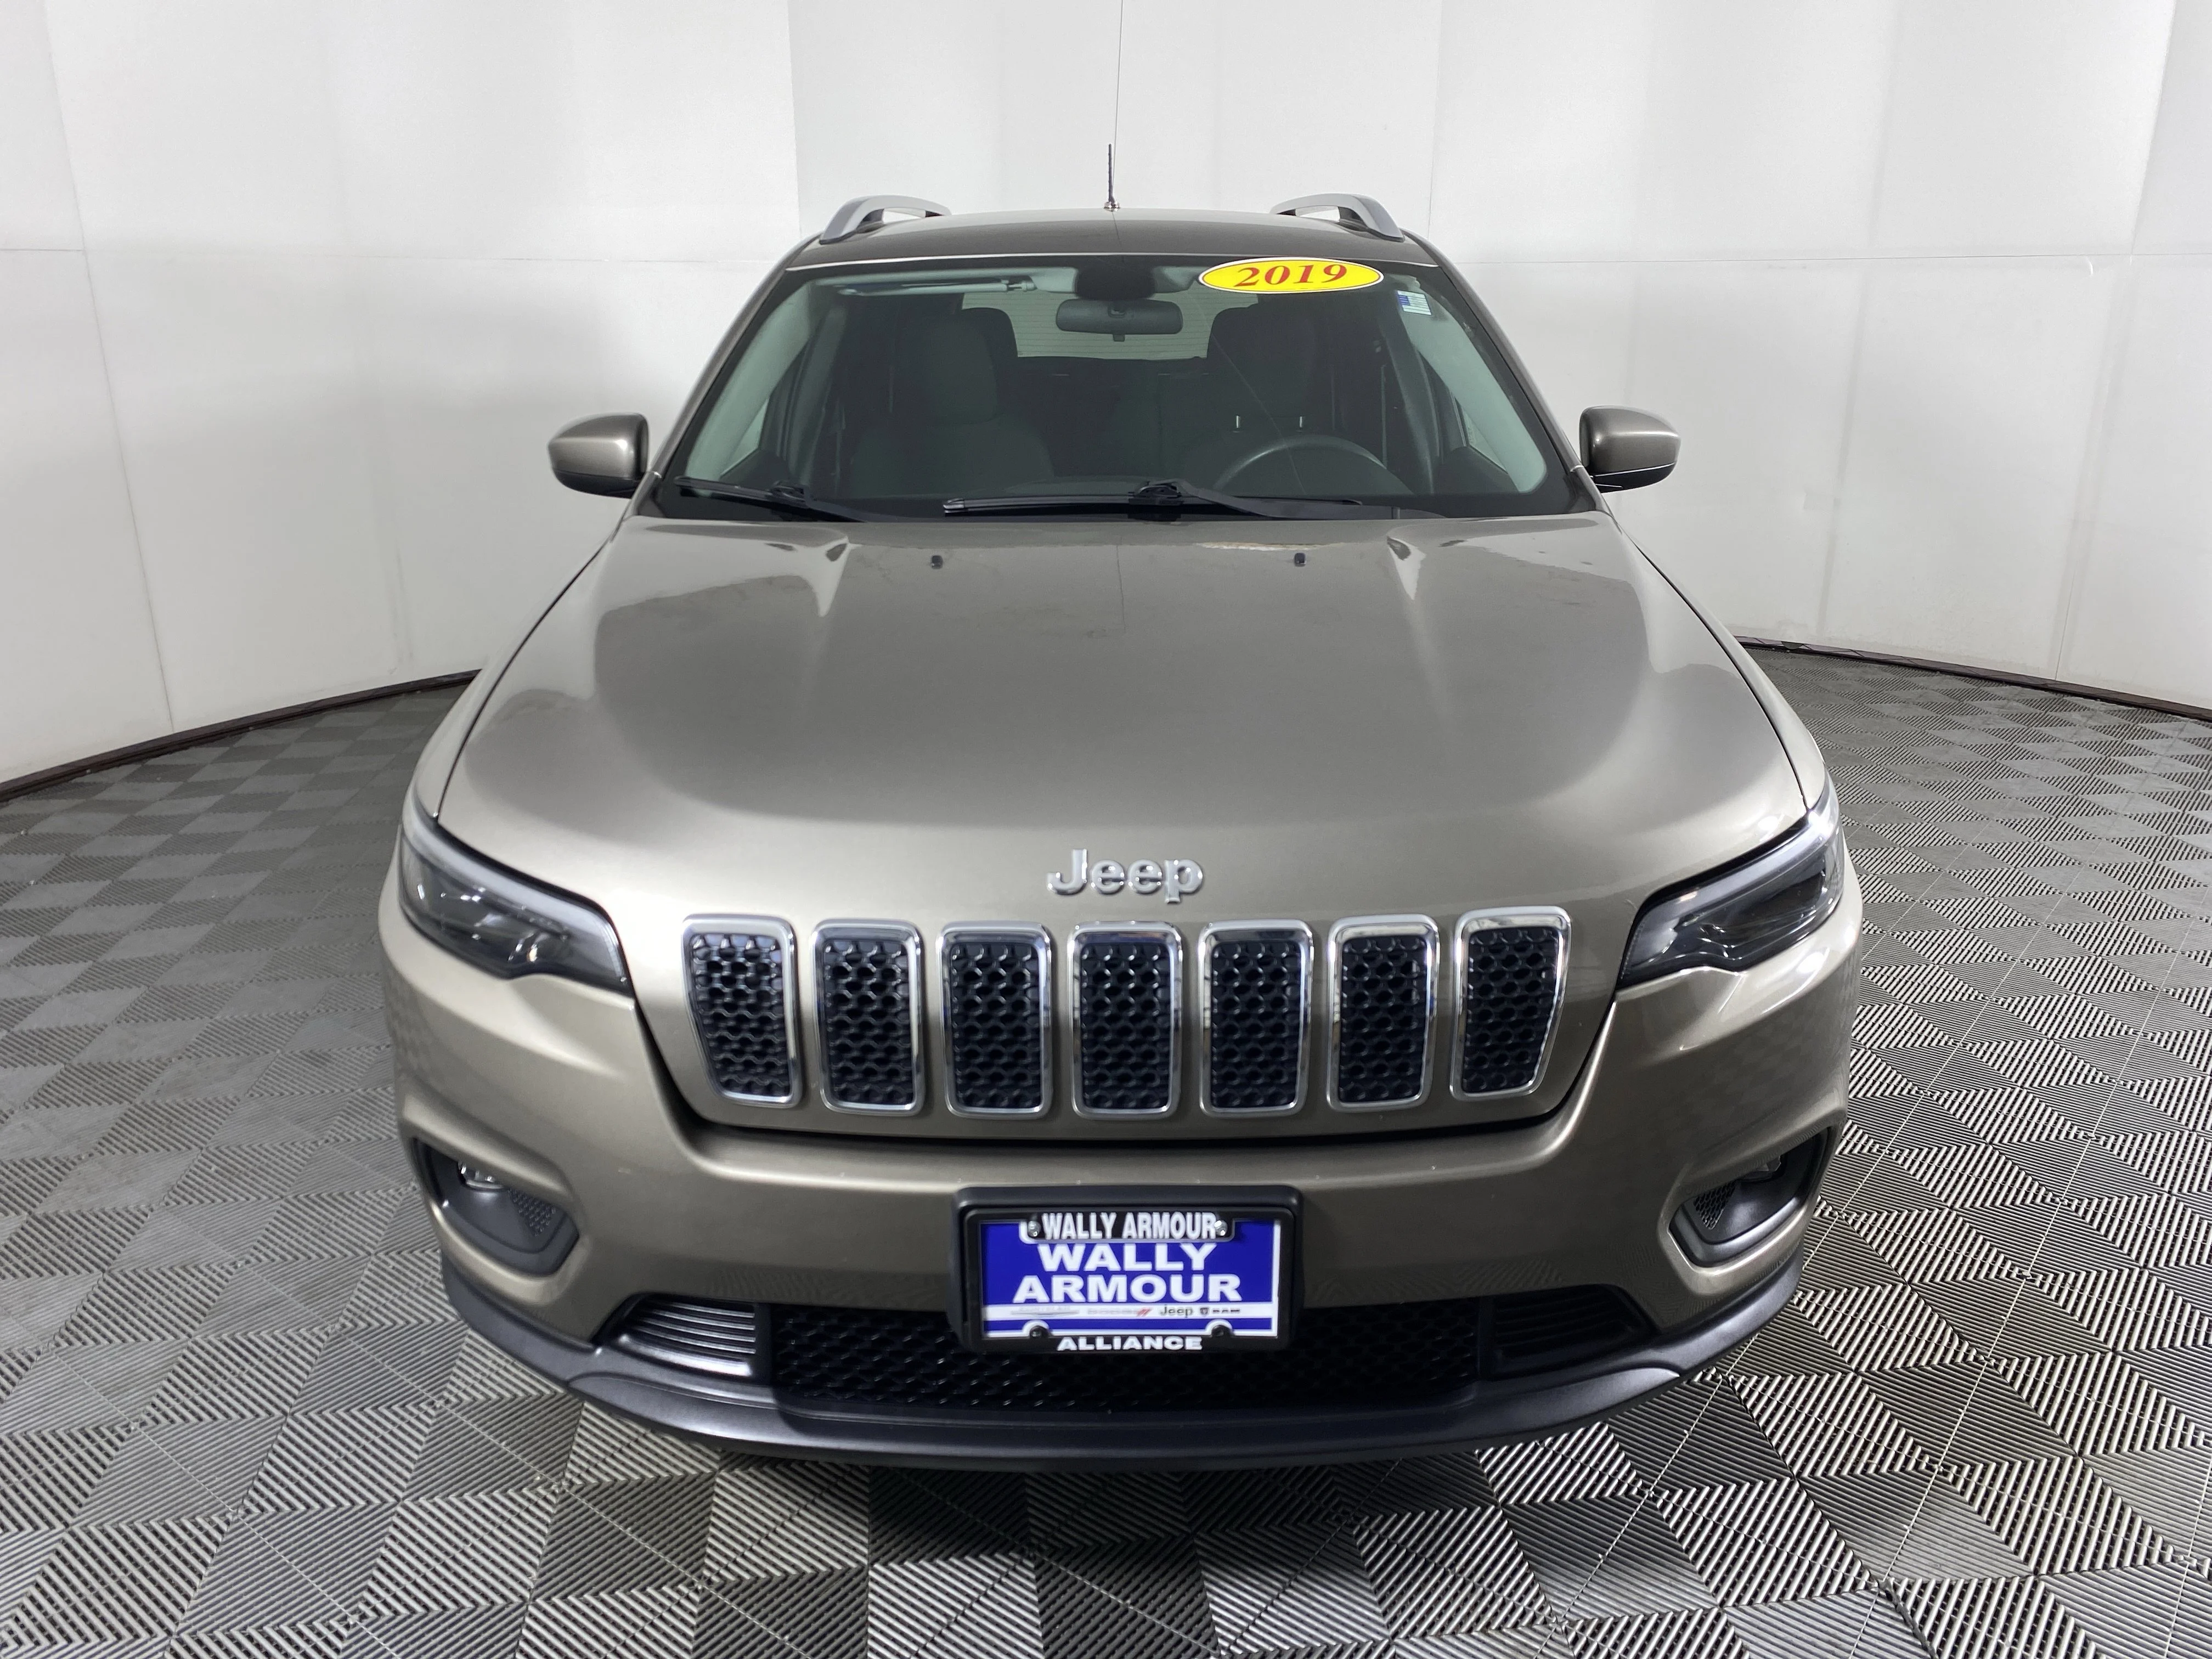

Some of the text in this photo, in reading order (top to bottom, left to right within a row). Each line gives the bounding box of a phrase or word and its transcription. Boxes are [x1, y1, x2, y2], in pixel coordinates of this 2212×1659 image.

[1234, 264, 1347, 287] 2019
[1047, 848, 1204, 905] Jeep
[1042, 1211, 1216, 1240] WALLY ARMOUR
[1037, 1243, 1217, 1272] WALLY
[1012, 1274, 1242, 1303] ARMOUR
[1160, 1304, 1193, 1318] Jeep
[1057, 1336, 1203, 1351] ALLIANCE
